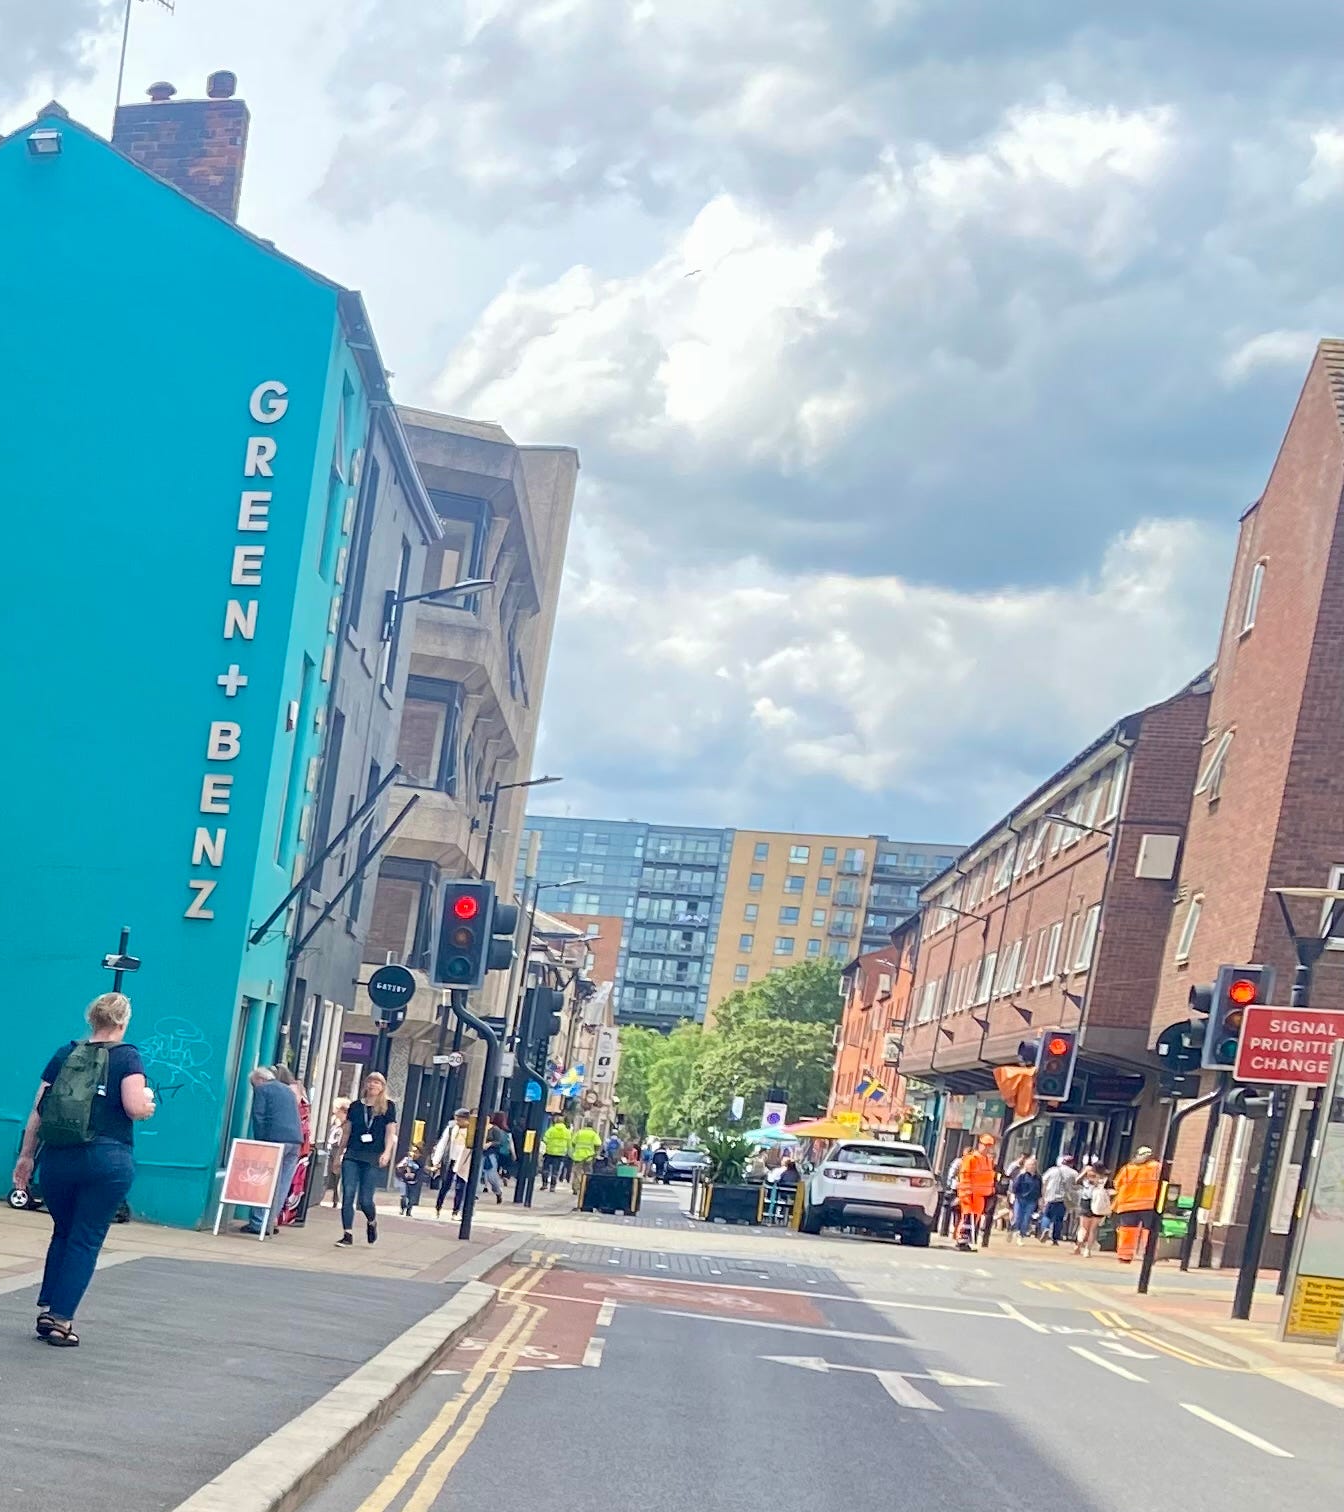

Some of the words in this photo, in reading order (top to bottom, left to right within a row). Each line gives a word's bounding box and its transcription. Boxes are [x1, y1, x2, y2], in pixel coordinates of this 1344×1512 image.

[223, 380, 289, 640] GREEN
[184, 721, 243, 920] BENZ
[1269, 1019, 1337, 1036] SIGNAL
[1250, 1037, 1334, 1055] PRIORITIE
[1250, 1056, 1329, 1074] CHANGE
